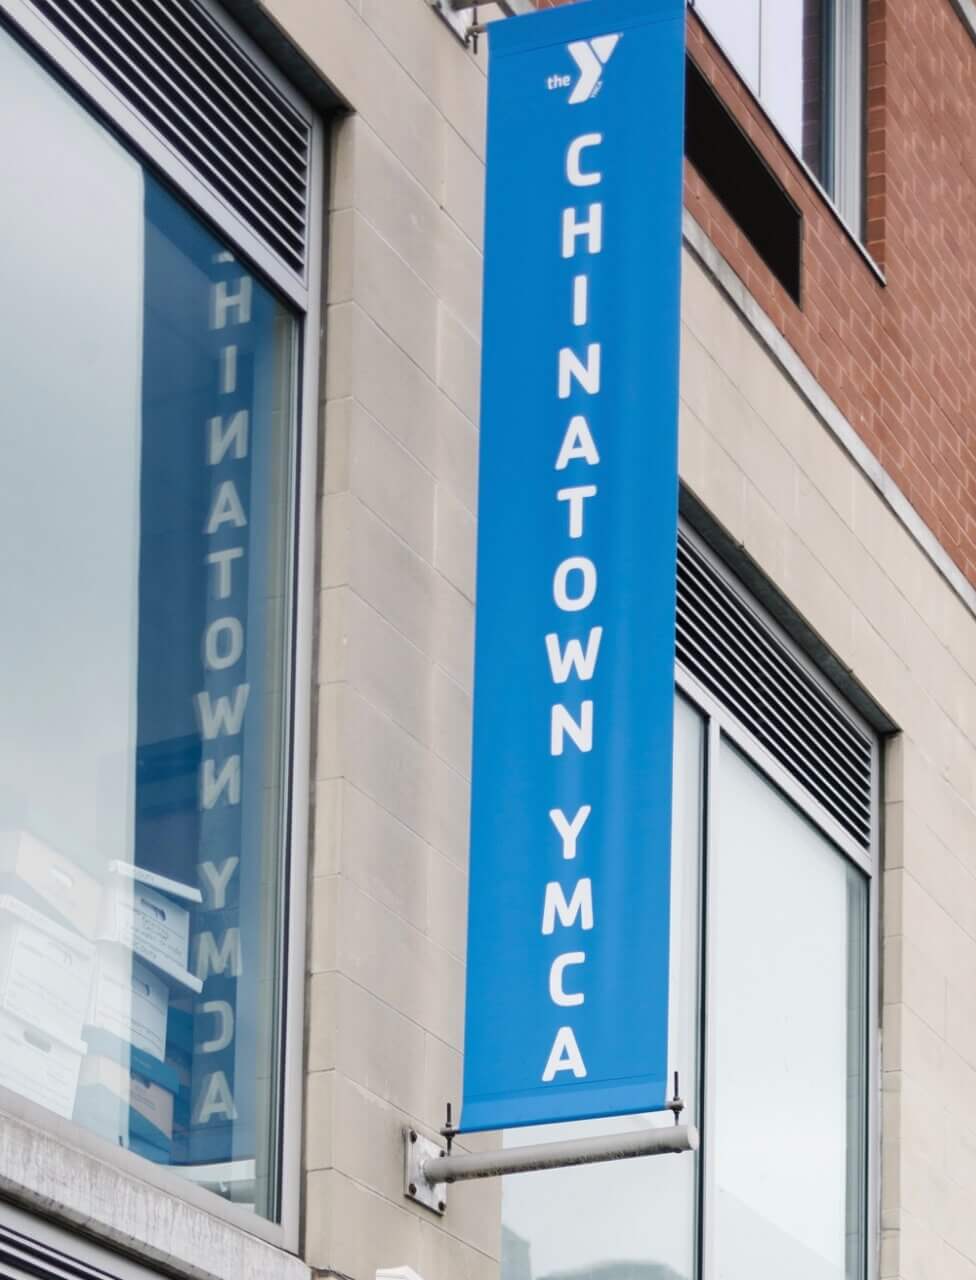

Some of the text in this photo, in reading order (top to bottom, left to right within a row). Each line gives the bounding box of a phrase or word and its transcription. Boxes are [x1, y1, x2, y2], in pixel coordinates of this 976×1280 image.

[547, 74, 571, 91] the
[541, 133, 603, 1083] CHINATOWN YMCA
